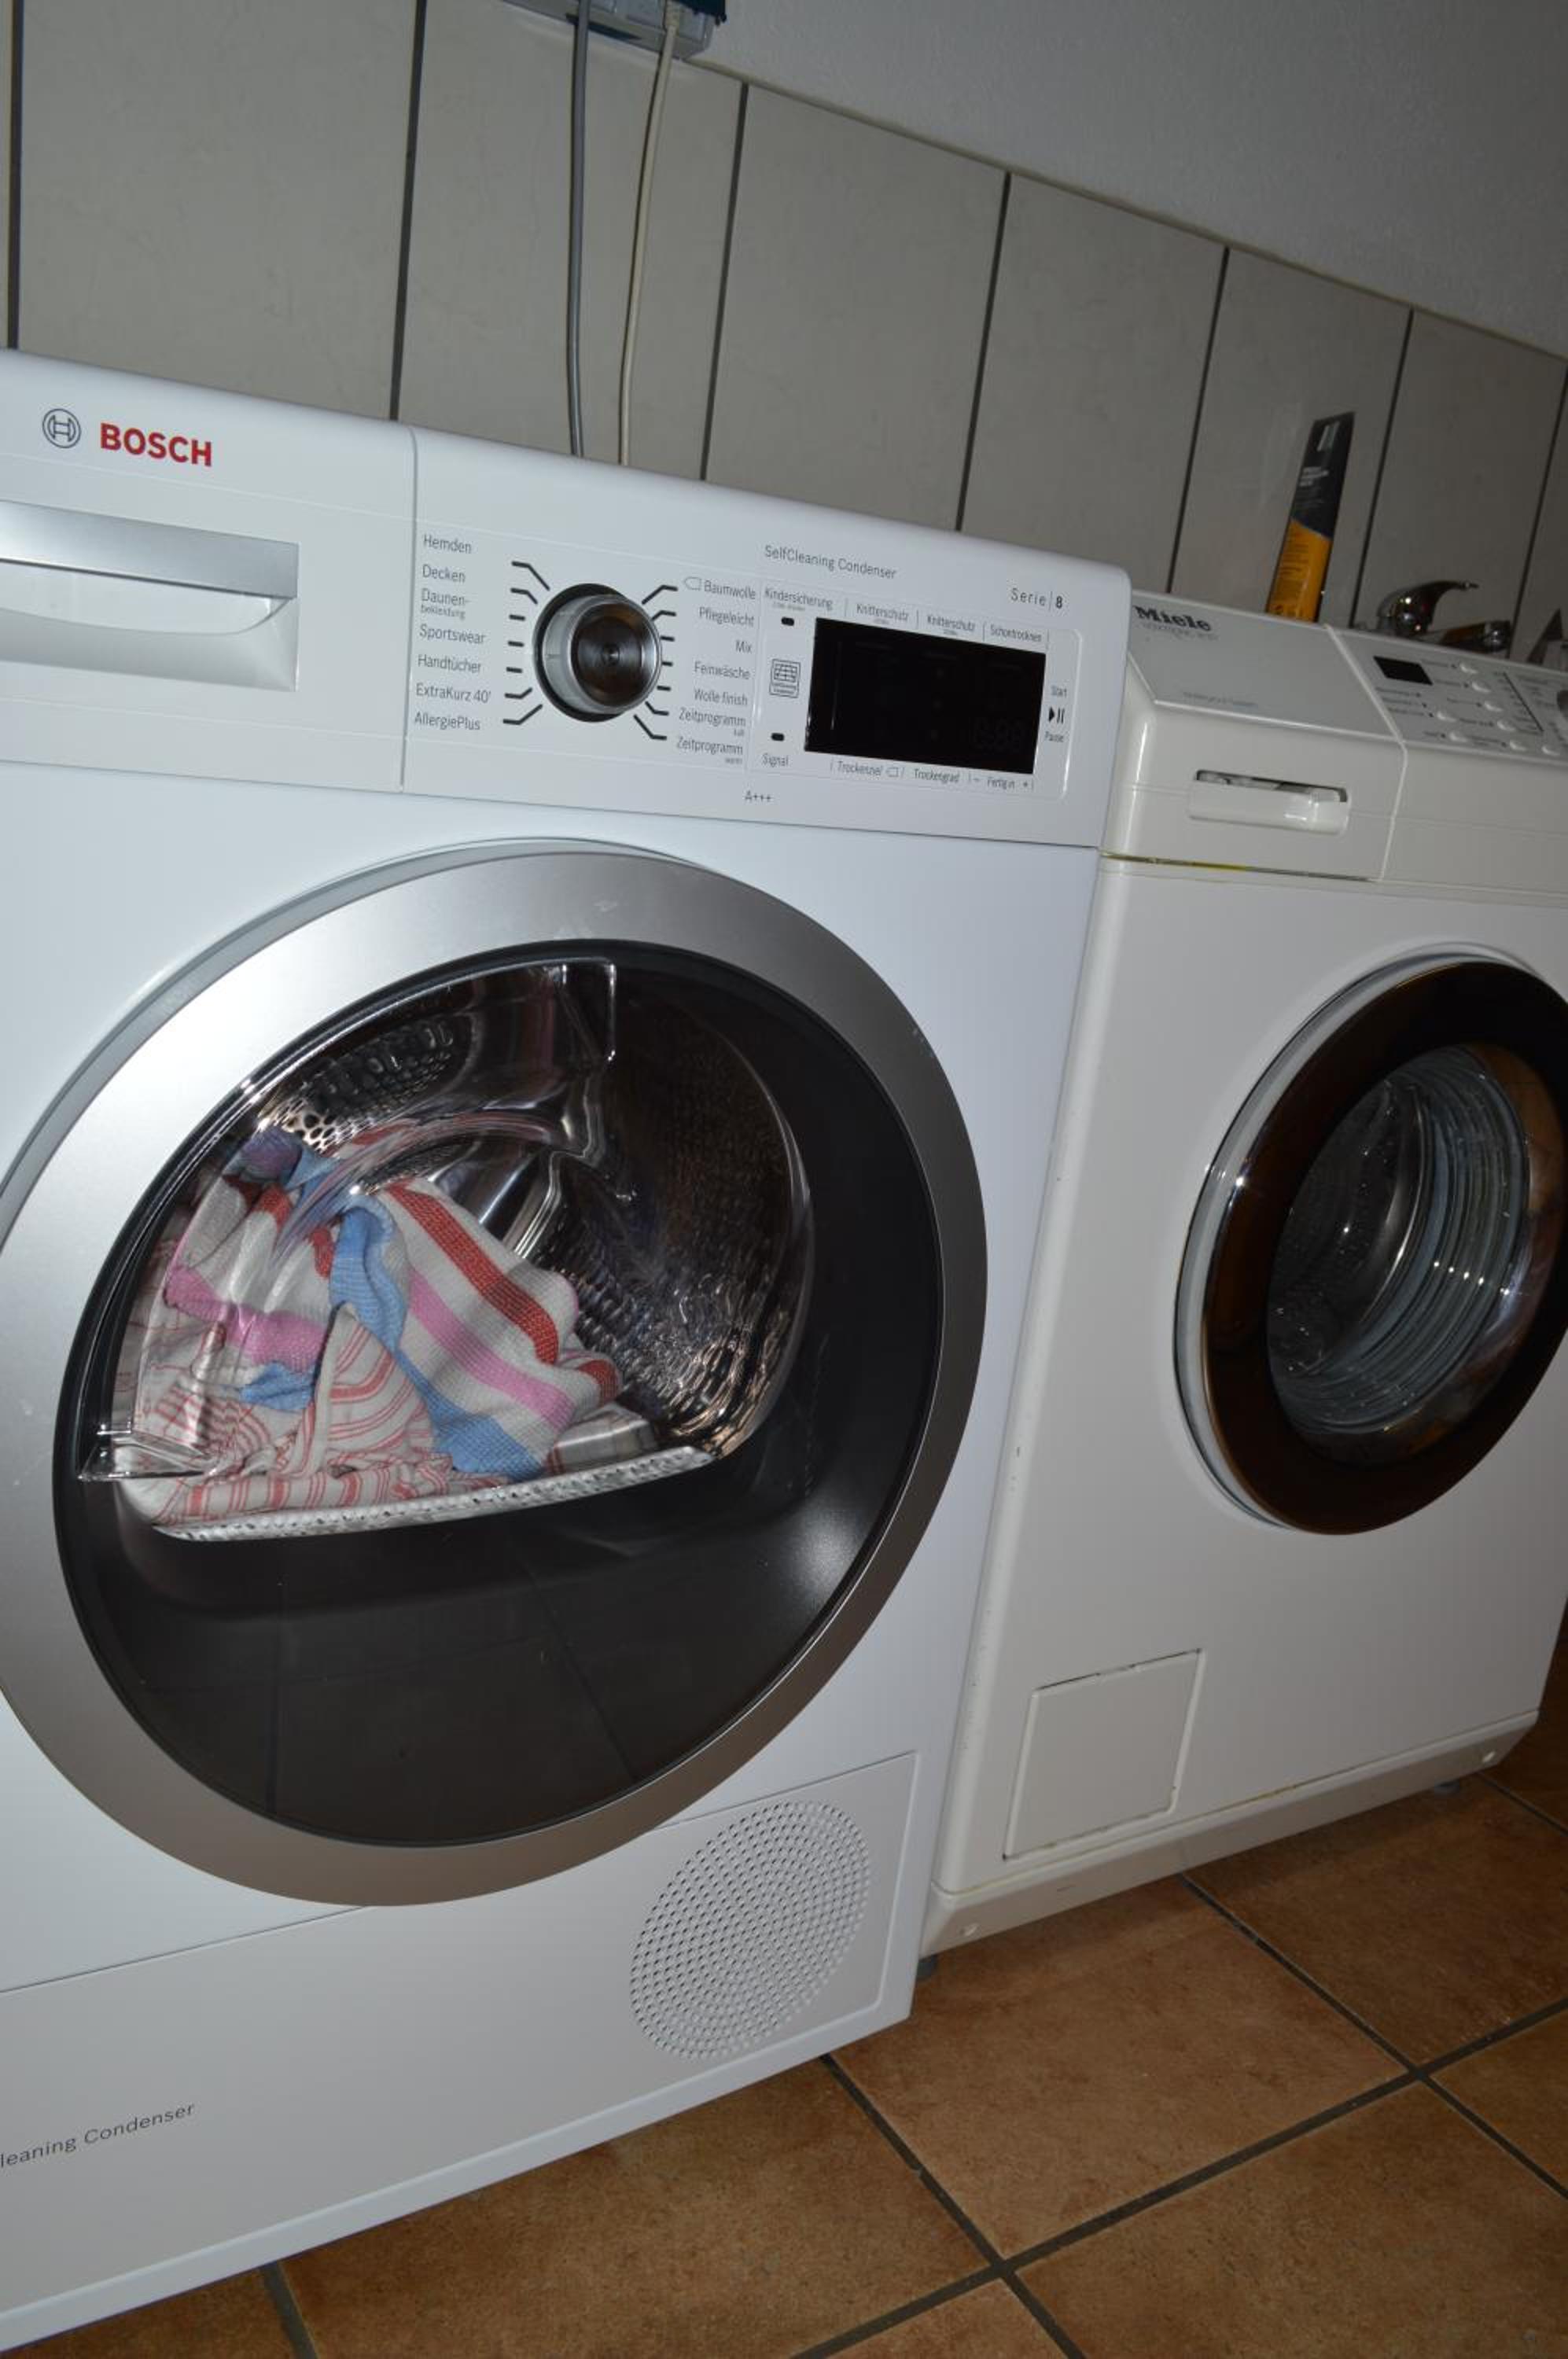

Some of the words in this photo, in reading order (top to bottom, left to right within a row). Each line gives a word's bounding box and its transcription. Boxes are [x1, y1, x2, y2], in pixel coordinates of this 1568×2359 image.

[100, 422, 212, 466] BOSCH
[423, 533, 472, 554] Hemden
[764, 544, 835, 572] SelfCleaning
[837, 558, 897, 579] Condenser
[422, 563, 466, 583] Decken
[421, 587, 472, 606] Daunen-
[704, 580, 756, 600] Baumwolle
[764, 588, 834, 611] Kindersicherung
[1010, 587, 1046, 606] Serie
[1055, 595, 1063, 609] 8
[699, 606, 755, 627] Pflegeleicht
[1135, 605, 1212, 632] Miele
[418, 623, 487, 644] Sportswear
[735, 640, 753, 653] Mix
[417, 653, 482, 674] Handtücher
[415, 682, 473, 703] ExtraKurz
[694, 688, 721, 704] Wolle
[722, 691, 748, 706] finish
[414, 710, 480, 731] AllergiePlus
[679, 707, 747, 728] Zeitprogramm
[677, 736, 744, 756] Zeitprogramm
[762, 753, 789, 768] Signal
[84, 2103, 195, 2144] Condenser
